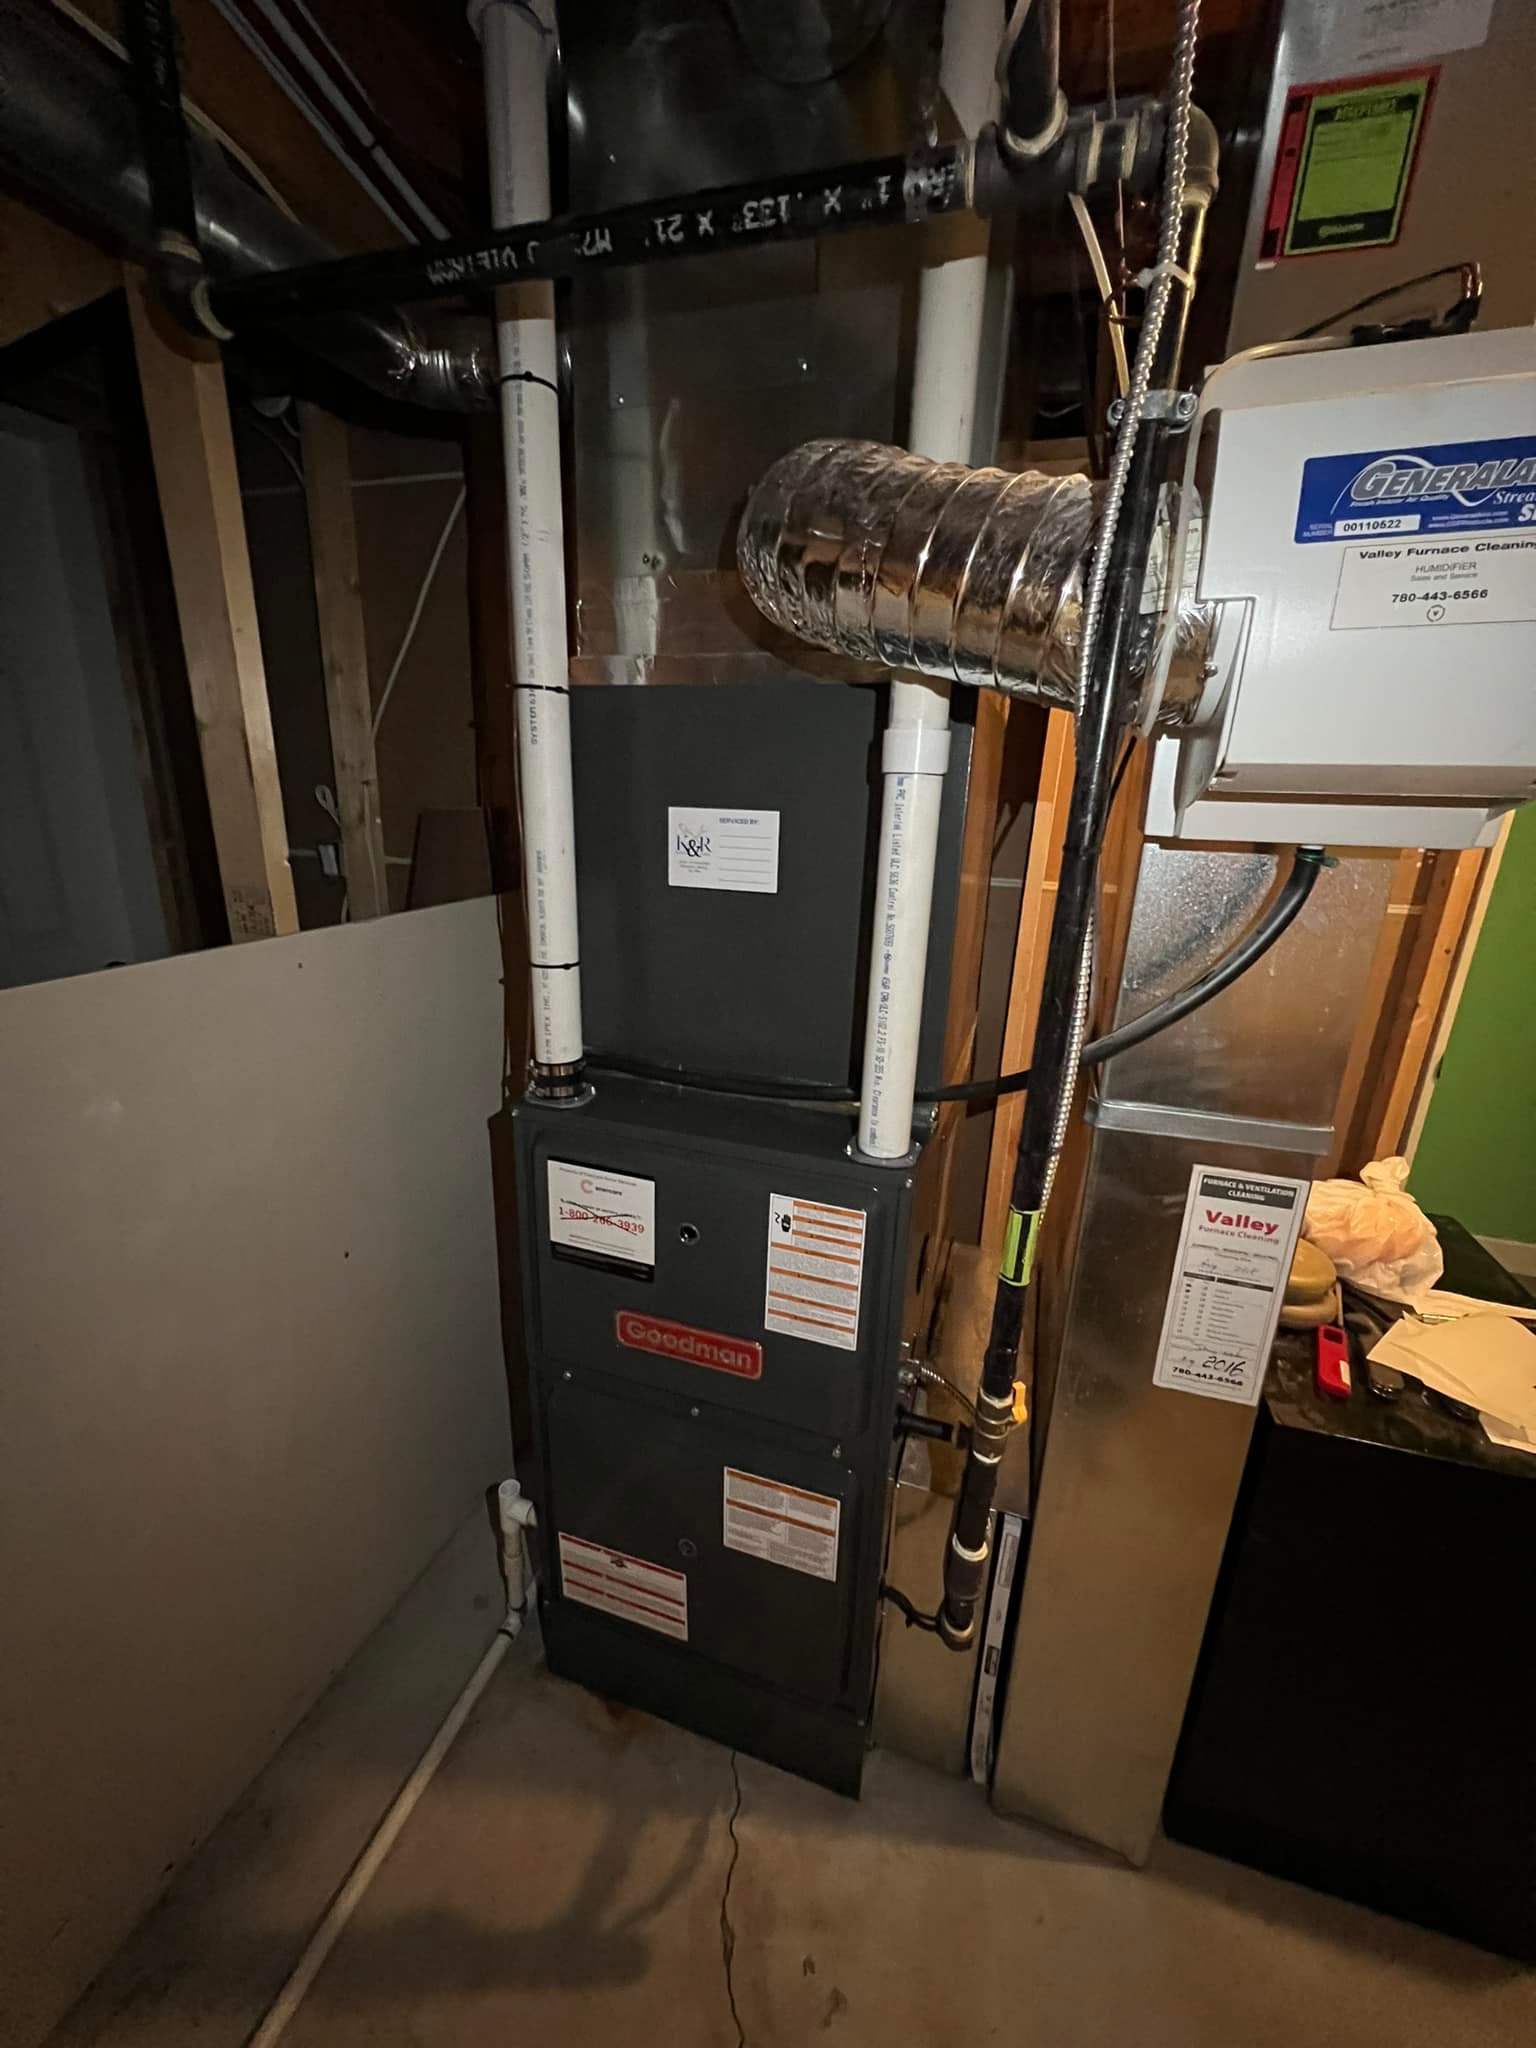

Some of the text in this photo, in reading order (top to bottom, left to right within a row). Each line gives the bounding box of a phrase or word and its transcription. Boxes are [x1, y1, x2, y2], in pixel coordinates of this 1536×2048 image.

[824, 185, 843, 216] X
[696, 210, 715, 237] X
[1359, 549, 1402, 560] Valley
[1406, 544, 1470, 556] Furnace
[1415, 561, 1477, 573] HUMIDIFIER
[1391, 588, 1489, 603] 780-443-6566
[676, 834, 712, 858] K&R
[1203, 1178, 1237, 1189] FURNACE
[1245, 1183, 1295, 1197] VENTILATION
[1228, 1190, 1265, 1201] CLEANING
[1206, 1209, 1279, 1235] Valley
[1199, 1224, 1280, 1245] Furnace Cleaning
[626, 1321, 752, 1369] Goodman
[1202, 1355, 1246, 1377] 2016
